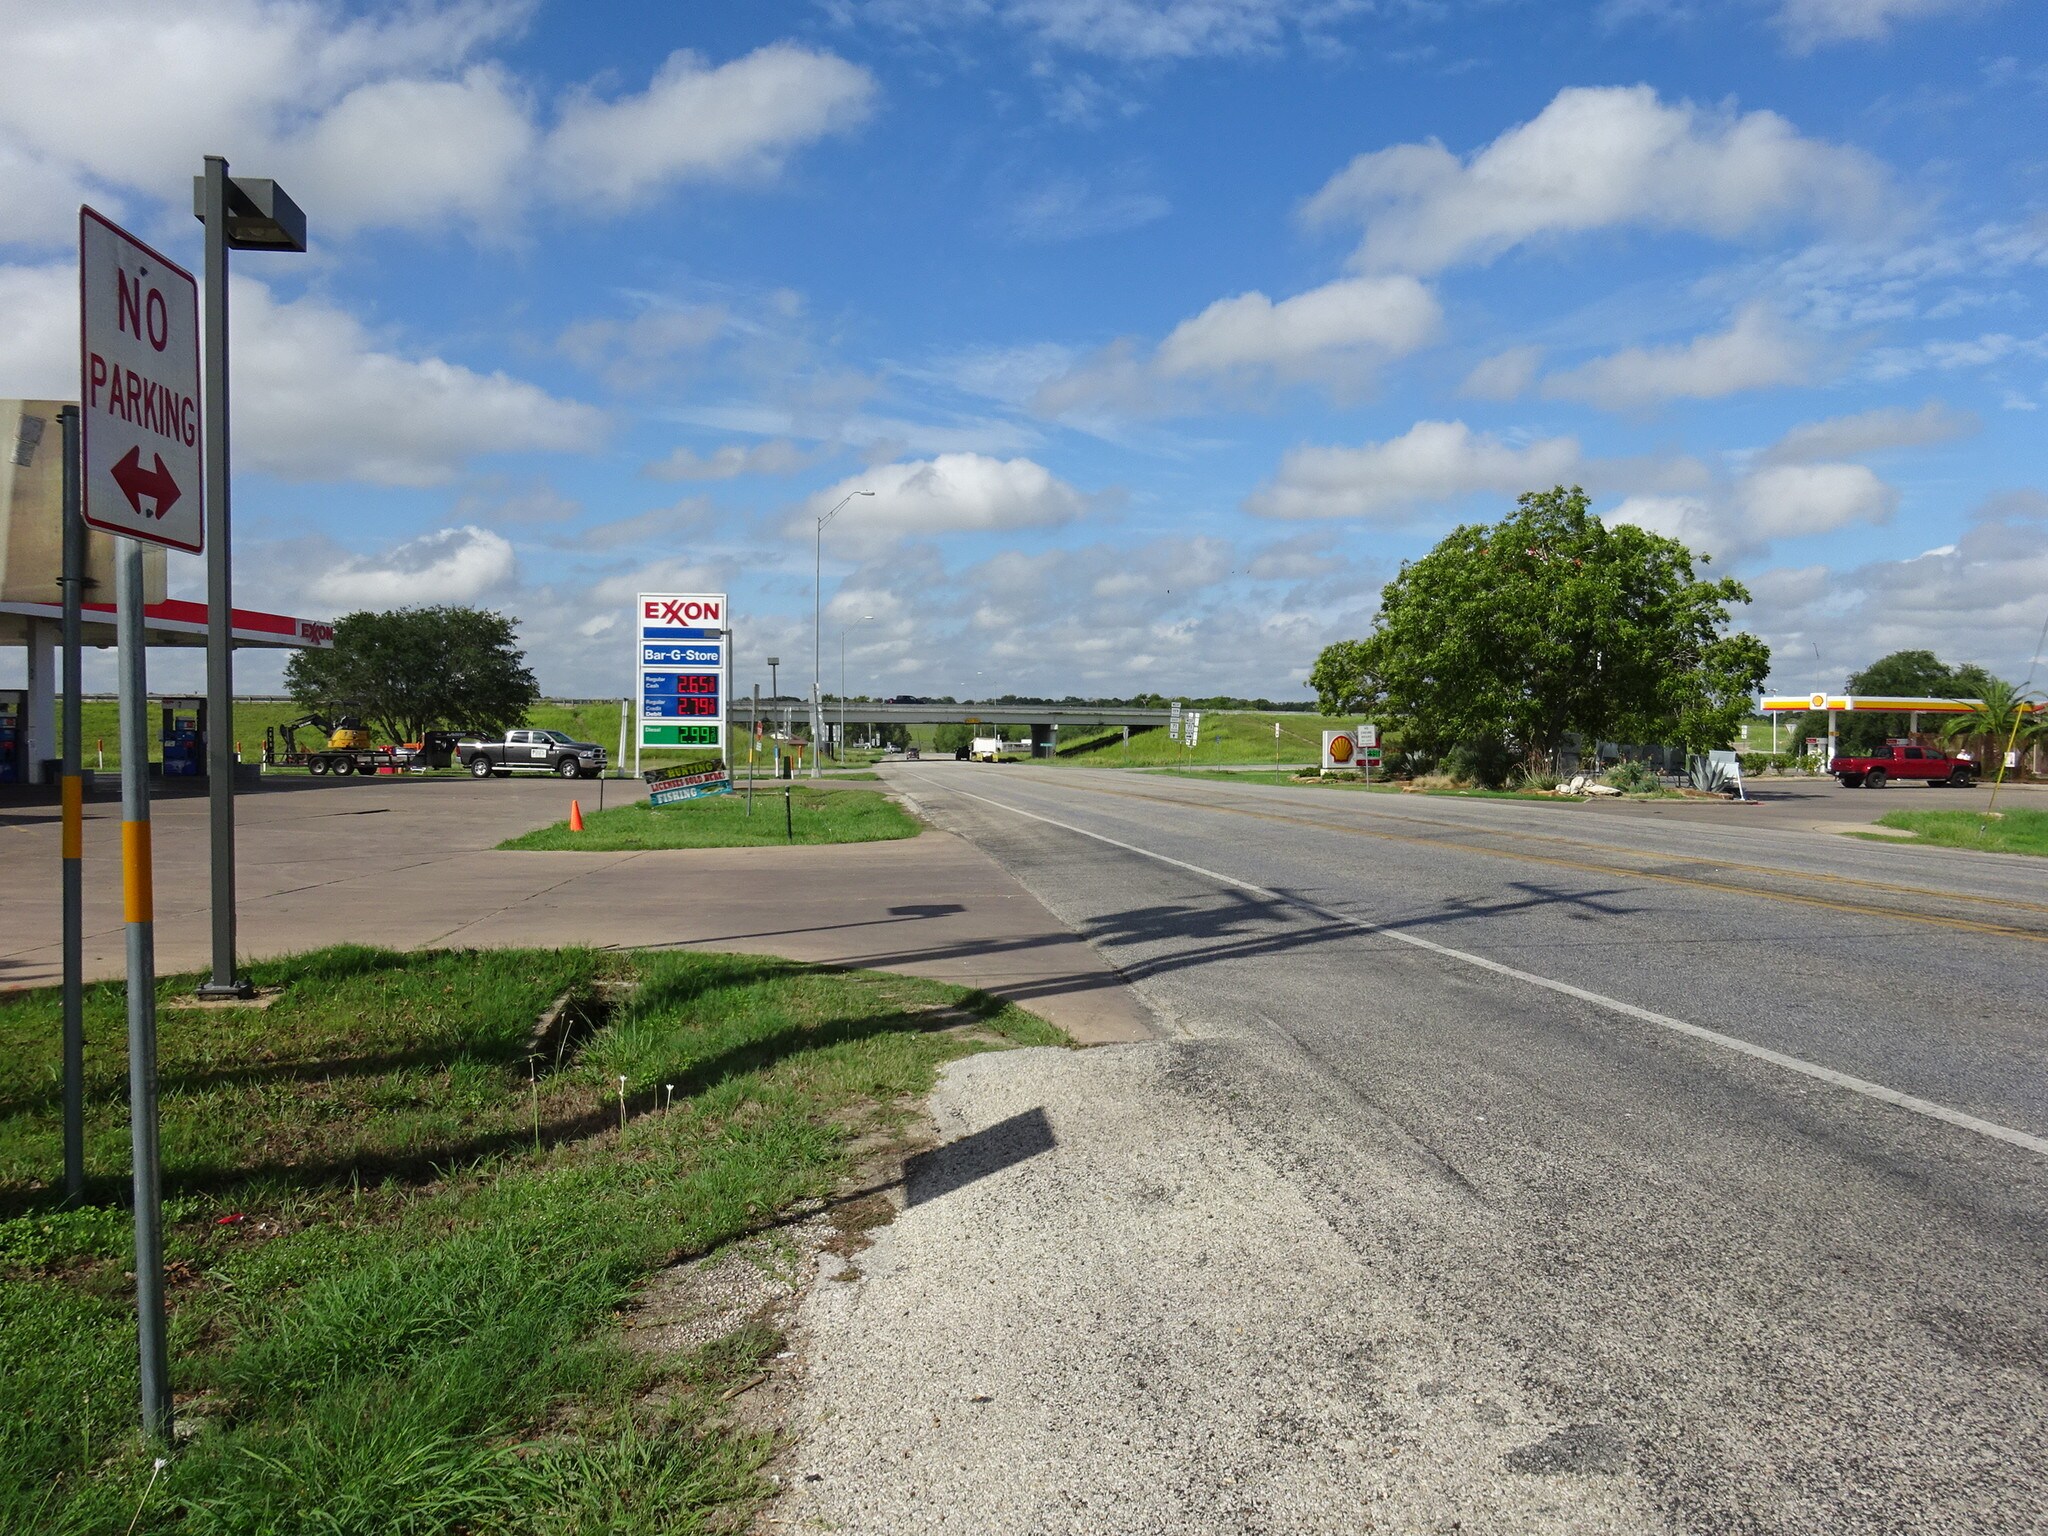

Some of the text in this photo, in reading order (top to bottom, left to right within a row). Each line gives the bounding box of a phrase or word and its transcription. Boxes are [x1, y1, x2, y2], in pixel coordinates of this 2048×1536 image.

[118, 267, 168, 352] NO
[90, 352, 196, 448] PARKING
[645, 599, 720, 627] EXXON
[302, 622, 333, 645] EXXON
[644, 649, 719, 661] Bar-G-Store
[678, 676, 708, 693] 2.65
[678, 698, 708, 715] 2.79
[680, 727, 709, 744] 2.99
[667, 761, 713, 778] HUNTING
[651, 771, 725, 792] LICENSES SOLD HERE!
[656, 787, 697, 804] FISHING
